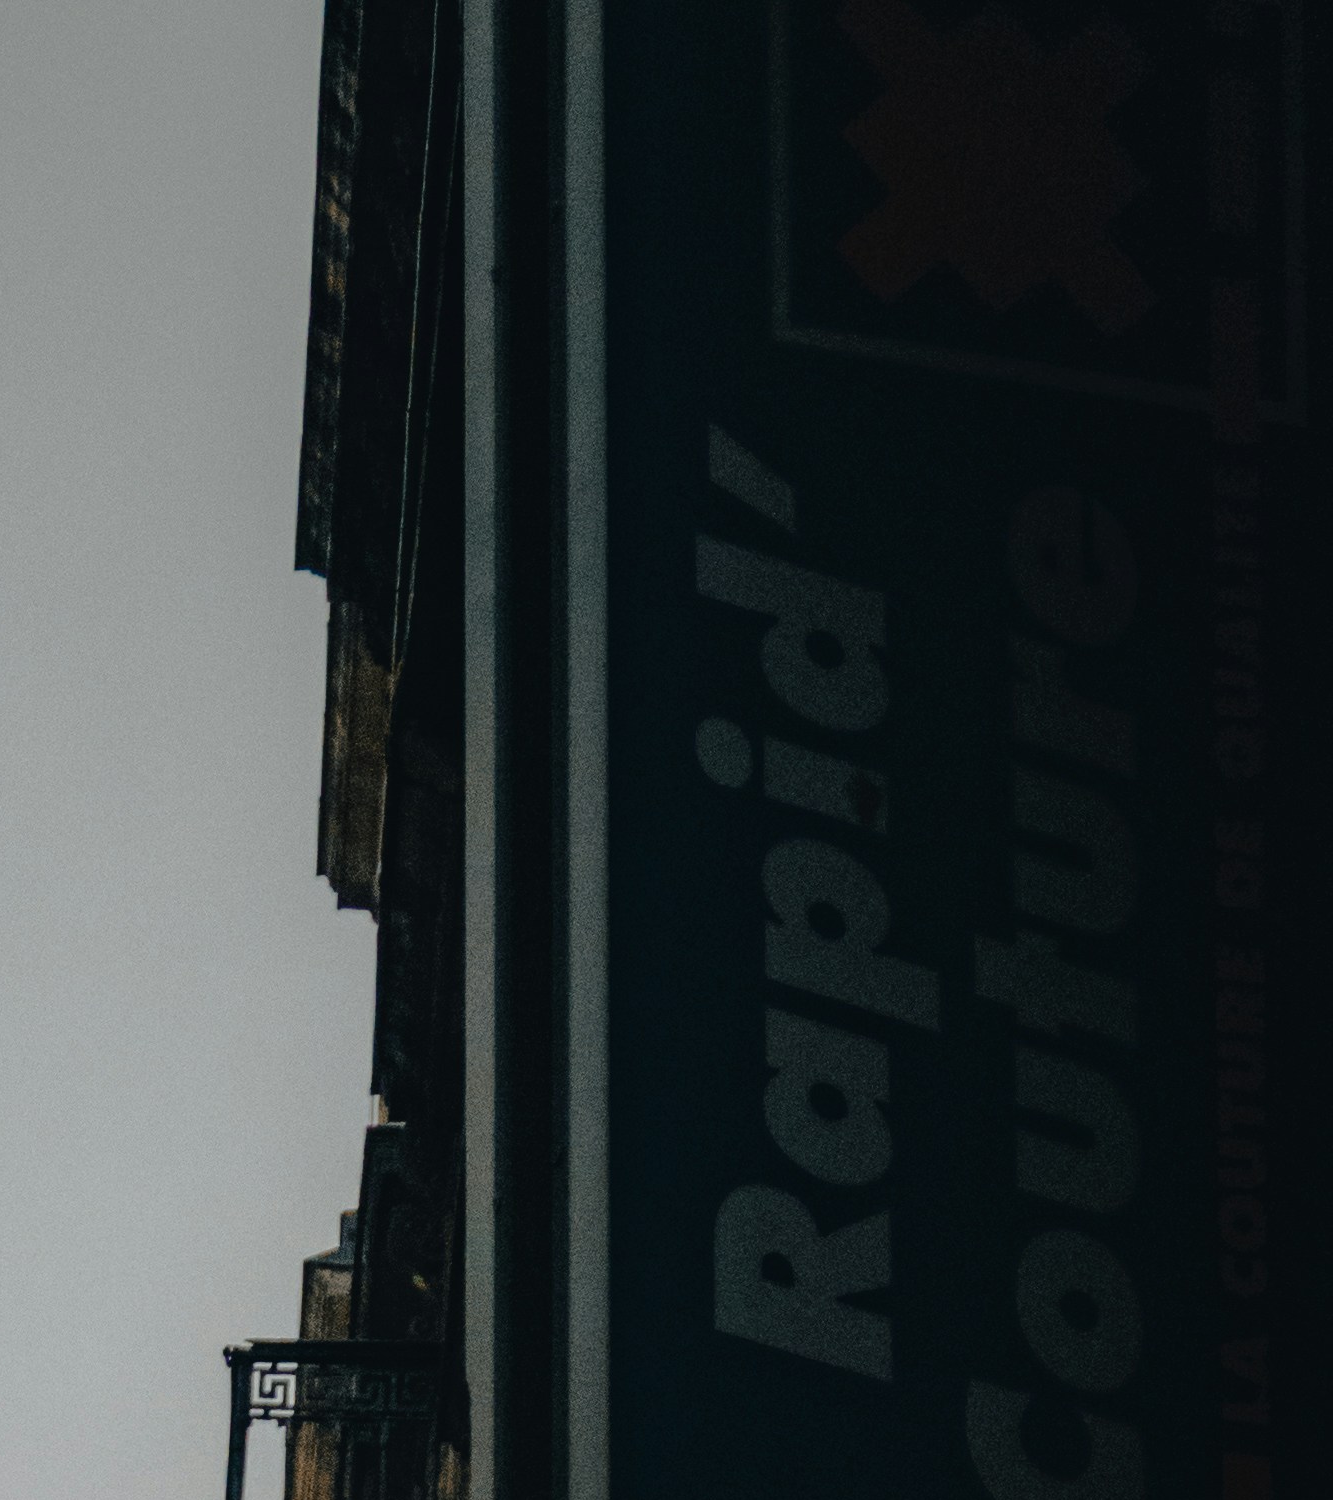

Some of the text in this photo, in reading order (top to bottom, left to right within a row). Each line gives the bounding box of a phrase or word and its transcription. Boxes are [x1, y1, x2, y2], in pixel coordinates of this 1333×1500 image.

[695, 422, 941, 1380] Rapid'
[1213, 816, 1265, 909] DE
[1215, 942, 1271, 1298] COUTURE
[1219, 1336, 1271, 1425] LA
